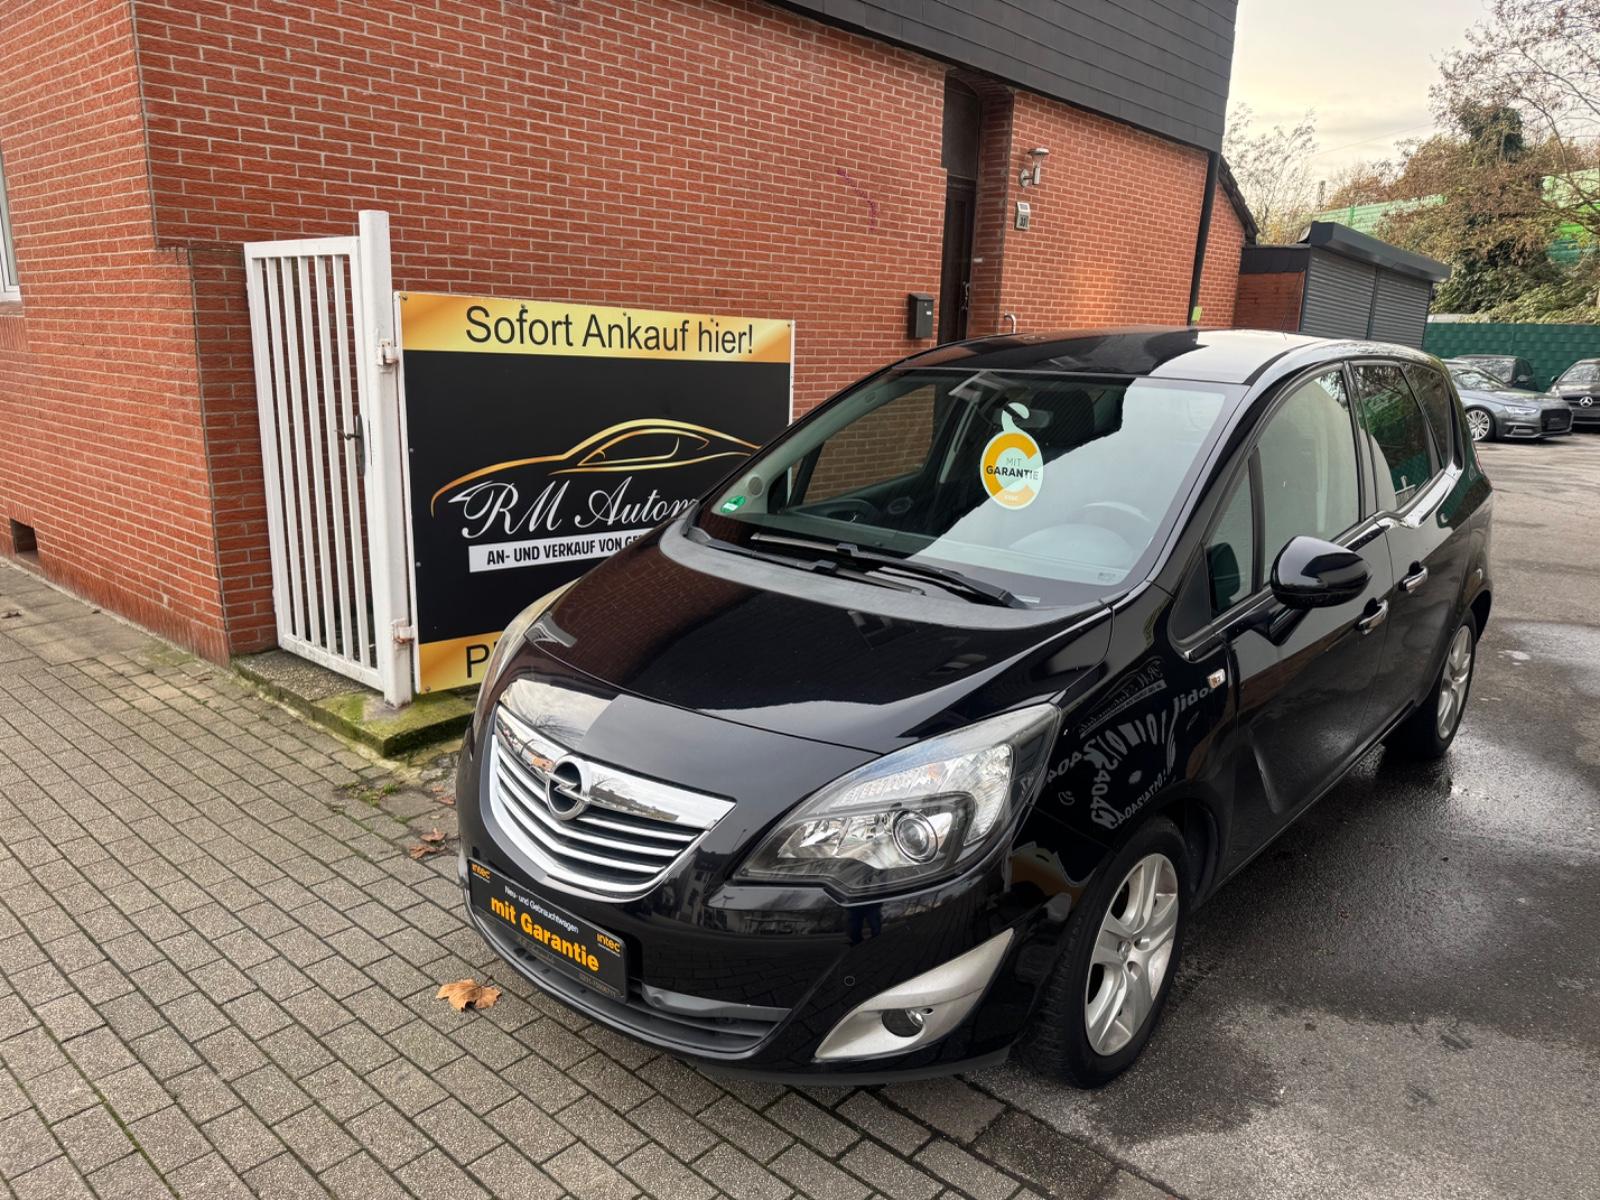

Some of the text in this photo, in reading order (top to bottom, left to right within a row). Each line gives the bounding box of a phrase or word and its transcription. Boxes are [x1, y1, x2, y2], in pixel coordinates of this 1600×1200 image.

[466, 305, 753, 354] Sofort Ankauf hier!
[986, 465, 1039, 480] GARANTIE
[1006, 457, 1021, 467] MIT
[448, 479, 570, 539] RM
[487, 549, 511, 566] AN-
[514, 545, 541, 562] UND
[543, 540, 596, 559] VERKAUF
[598, 536, 623, 552] VON
[518, 896, 530, 907] und
[529, 900, 579, 934] Gebrauchtwagen
[490, 897, 517, 924] mit
[520, 912, 600, 972] Garantie
[596, 932, 621, 953] intec
